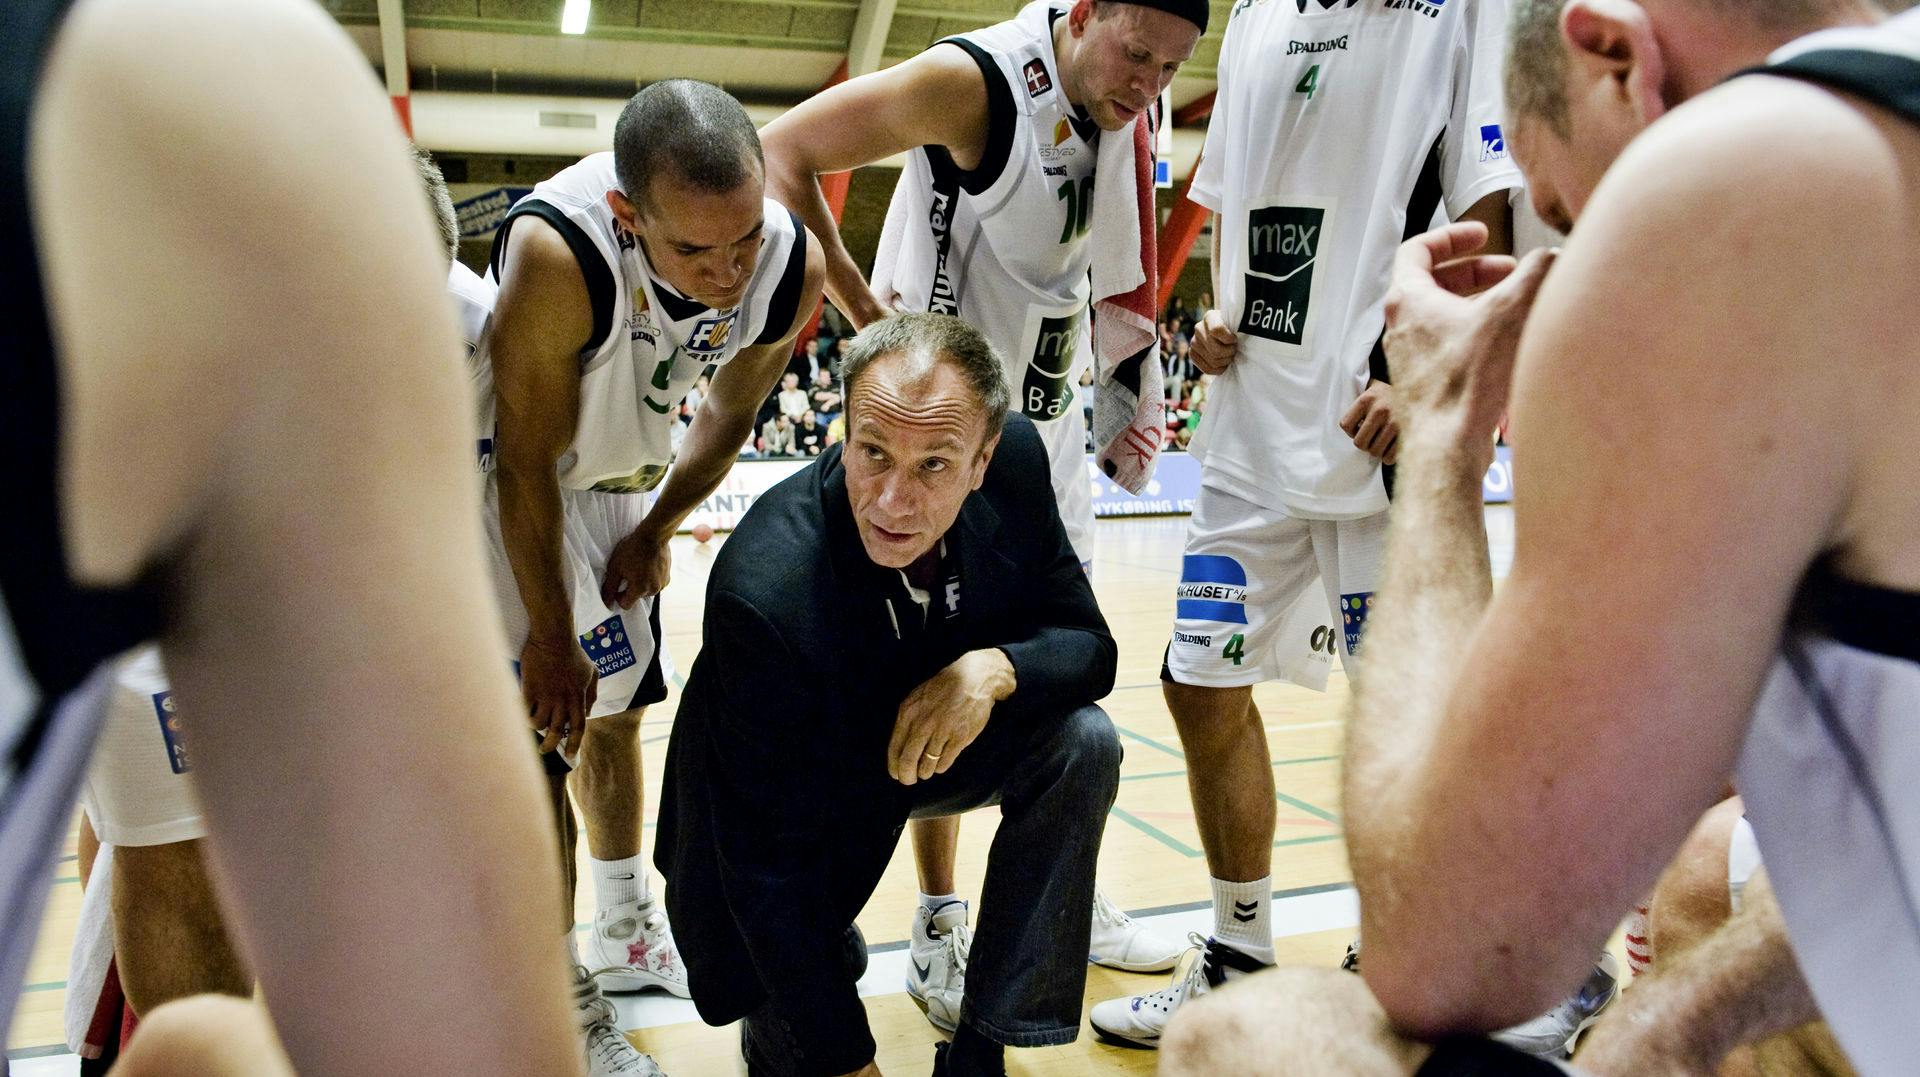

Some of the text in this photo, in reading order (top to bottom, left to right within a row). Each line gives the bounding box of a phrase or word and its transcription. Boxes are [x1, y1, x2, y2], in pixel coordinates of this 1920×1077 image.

[1287, 35, 1348, 55] SPALDING
[1027, 66, 1044, 89] 4
[1295, 64, 1320, 100] 4
[1030, 84, 1050, 96] SPORT
[1043, 165, 1067, 177] PALDING
[1252, 223, 1317, 257] max
[1248, 299, 1299, 335] Bank
[593, 646, 630, 667] KØBING
[1222, 633, 1244, 665] 4
